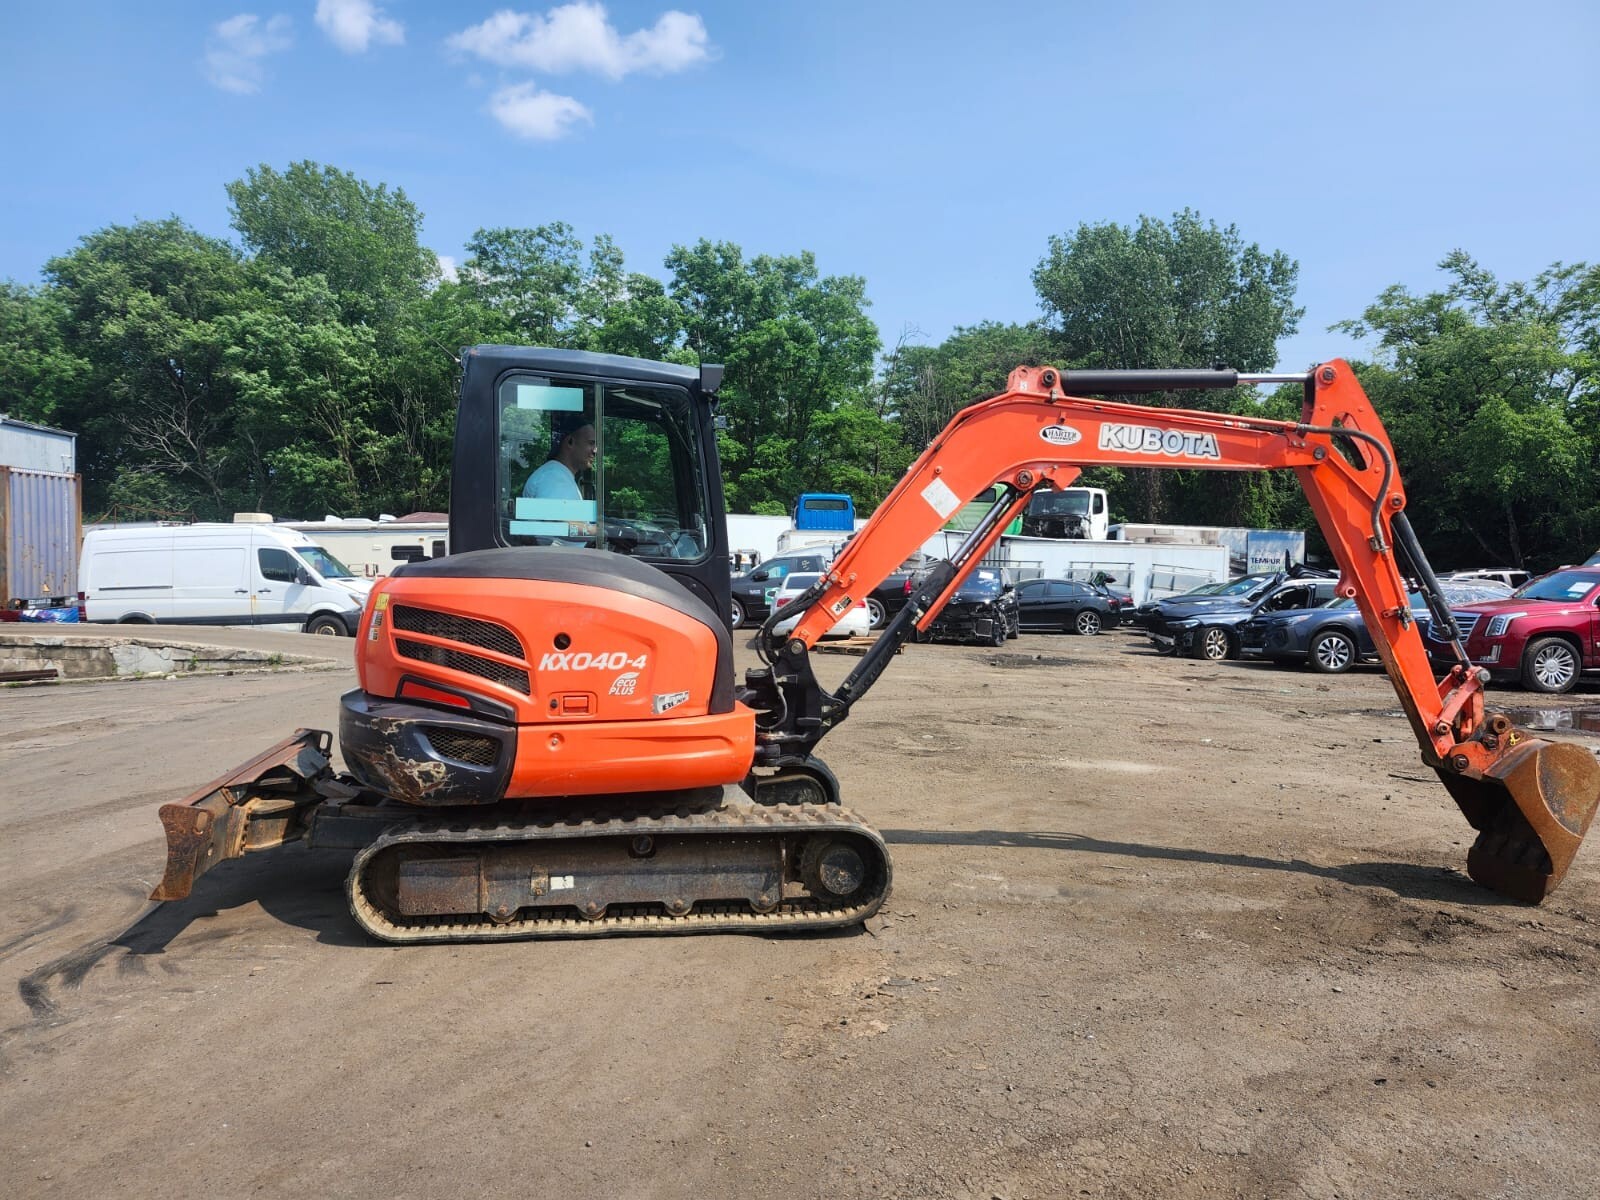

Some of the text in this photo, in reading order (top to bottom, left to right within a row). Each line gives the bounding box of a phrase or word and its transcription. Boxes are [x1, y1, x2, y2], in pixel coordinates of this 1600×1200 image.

[1047, 429, 1077, 438] HARTER
[1100, 423, 1220, 459] KUBOTA
[538, 651, 648, 671] KX040-4
[616, 679, 637, 687] eco
[608, 686, 635, 696] PLUS
